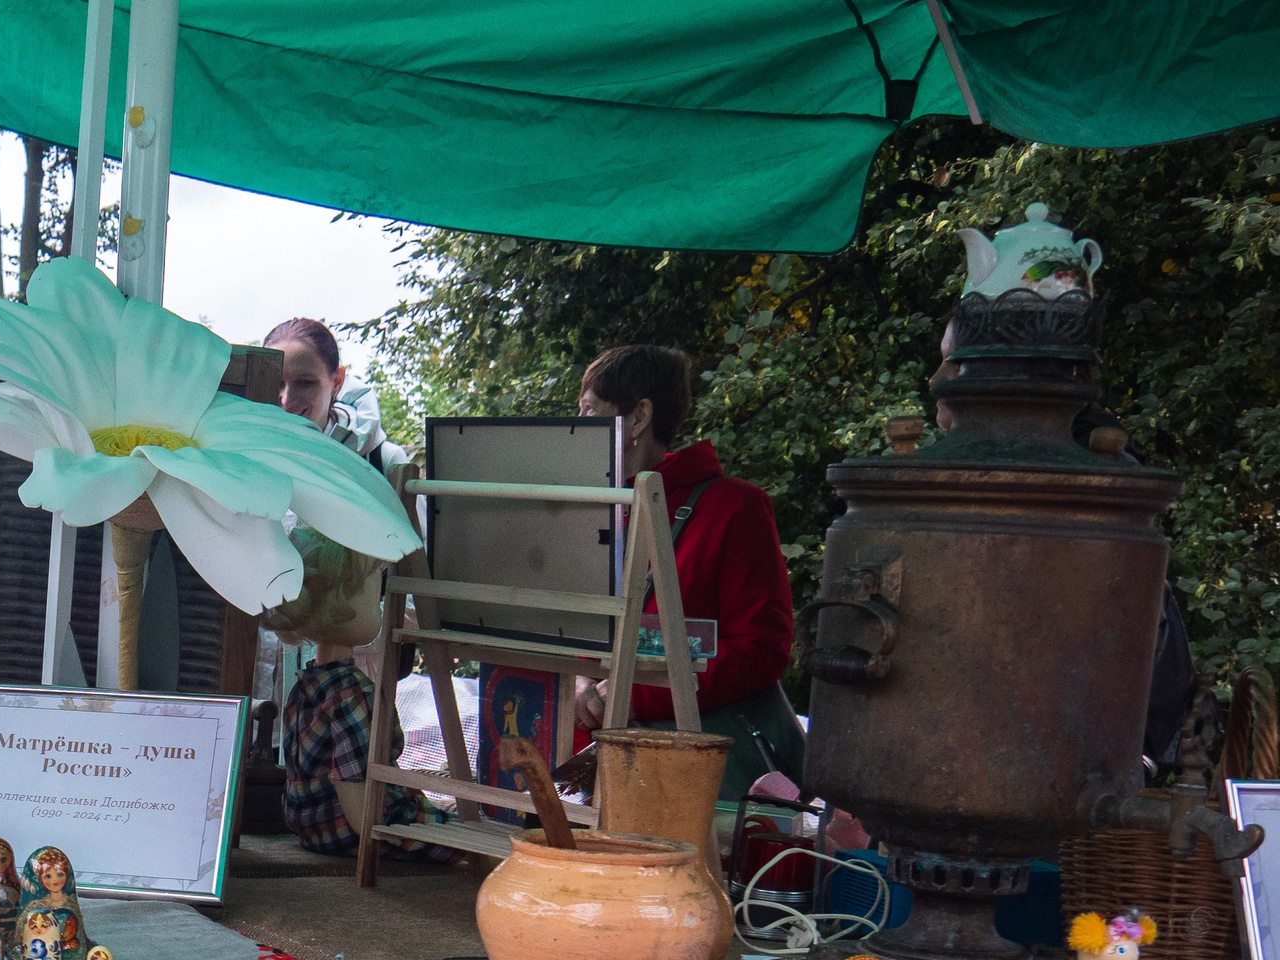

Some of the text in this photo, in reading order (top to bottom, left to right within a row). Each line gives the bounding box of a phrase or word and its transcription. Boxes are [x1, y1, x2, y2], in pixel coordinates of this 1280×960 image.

[134, 745, 197, 762] душа
[41, 757, 132, 778] России»
[60, 796, 97, 807] семьи
[100, 796, 176, 811] Долибожко
[31, 806, 63, 819] (1990
[72, 811, 101, 822] 2024
